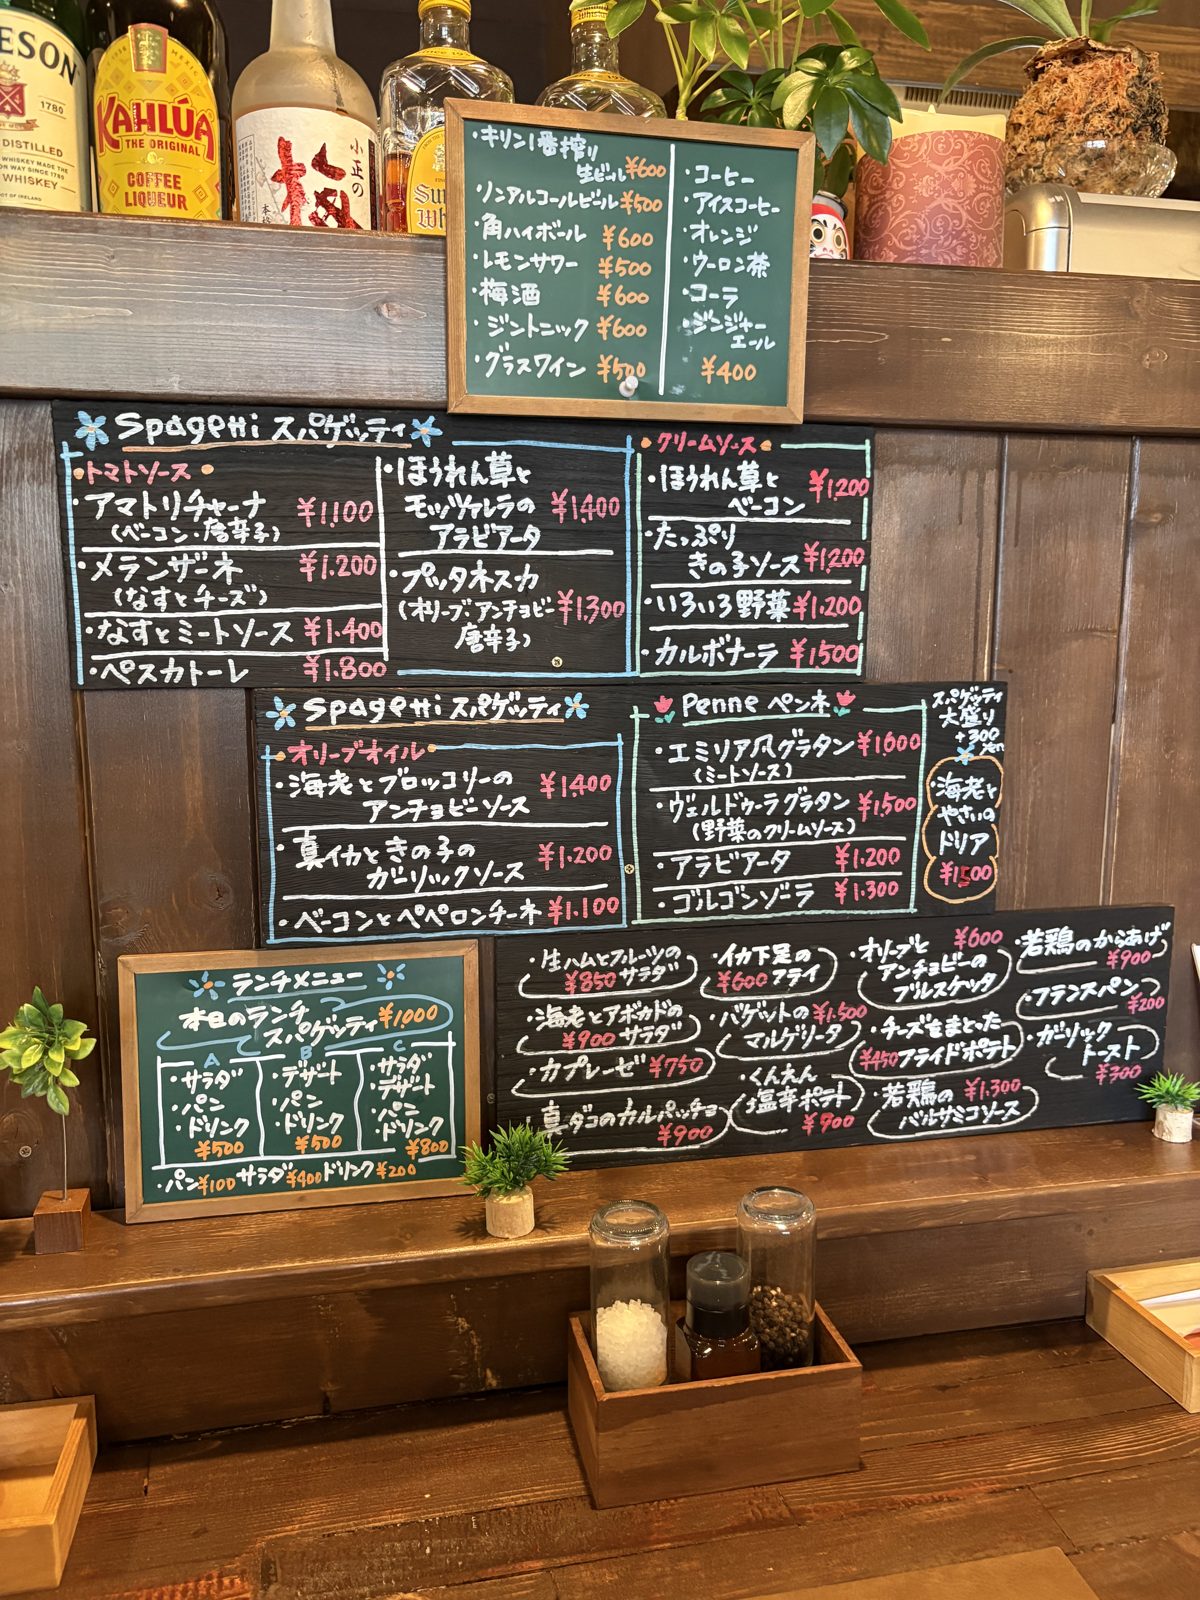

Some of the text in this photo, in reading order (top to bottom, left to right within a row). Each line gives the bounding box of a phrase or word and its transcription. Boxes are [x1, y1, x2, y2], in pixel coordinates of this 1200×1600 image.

[40, 100, 64, 115] 1780
[96, 95, 214, 162] KAHLÚA
[2, 139, 63, 157] DISTILLED
[125, 139, 200, 157] THE ORIGINAL
[2, 156, 69, 175] WHISKEY MADE THE
[28, 167, 48, 176] SINCE
[350, 137, 364, 197] 小正の
[577, 156, 666, 184] 生ビール ¥600
[695, 165, 754, 186] コーヒー
[3, 174, 58, 190] WHISKEY
[127, 171, 182, 190] COFFEE
[125, 192, 188, 211] LIQUEUR
[620, 190, 663, 215] ¥500
[694, 192, 780, 216] アイスコーヒー
[482, 213, 653, 250] 角ハイボール ¥600
[690, 219, 758, 246] オレンジ
[484, 250, 651, 278] レモンサワー ¥500
[692, 252, 770, 279] ウーロン茶
[479, 277, 649, 307] 梅酒 ¥600
[690, 283, 739, 309] コーラ
[488, 313, 647, 342] ジントニック ¥600
[691, 309, 766, 335] ジンジャー
[731, 336, 776, 351] エール
[485, 343, 586, 378] グラスワイン
[701, 354, 756, 385] ¥400
[272, 412, 406, 448] スパゲッティ
[657, 431, 756, 456] クリームソース
[87, 460, 192, 485] トマトソース
[398, 451, 532, 489] ほうれん草と
[661, 460, 779, 493] ほうれん草と
[84, 488, 266, 522] アマトリチャーナ
[728, 496, 806, 517] ベーコン
[429, 523, 541, 550] アラビアータ
[653, 521, 736, 550] たっぷり
[91, 551, 243, 585] メランザーネ
[402, 559, 539, 594] プッタネスカ
[688, 551, 800, 579] きの子ソース
[657, 589, 791, 622] いろいろ野菜
[98, 617, 294, 646] なすとミートソース
[655, 633, 778, 669] カルボナーラ
[100, 657, 249, 686] ペスカトーレ
[449, 691, 562, 720] スパゲッティ
[682, 689, 831, 717] Penne ペンネ
[932, 685, 1003, 709] スパゲッティ
[939, 707, 995, 728] 大盛り
[287, 739, 425, 766] オリーブオイル
[289, 766, 513, 798] 海老とブロッコリーの
[936, 771, 998, 802] 海老と
[937, 804, 996, 827] やさいの
[292, 829, 476, 871] 真イカときの子の
[939, 829, 990, 856] ドリア
[367, 860, 525, 893] ガーリックソース
[671, 850, 791, 881] アラビアータ
[673, 881, 815, 914] ゴルゴンゾーラ
[294, 898, 542, 933] ベーコンとペペロンチーネ
[718, 942, 812, 967] イカ下足の
[858, 926, 1003, 963] オリーブと ¥600
[1020, 922, 1171, 959] 若鶏のからあげ
[541, 945, 681, 972] 生ハムとフルーツの
[877, 952, 987, 981] アンチョビーの
[1106, 949, 1151, 970] ¥900
[232, 969, 363, 996] ランチメニュー
[565, 962, 680, 994] ¥850 サラダ
[717, 963, 820, 993] ¥600 フライ
[893, 972, 997, 1003] ブルスケッタ
[1032, 976, 1139, 1007] フランスパン
[179, 1000, 310, 1032] 本日のランチ
[535, 999, 683, 1031] 海老とアボカドの
[719, 1000, 809, 1028] バゲットの
[1127, 991, 1165, 1014] ¥200
[263, 1015, 378, 1047] スパゲッティ
[562, 1021, 682, 1049] ¥900 サラダ
[744, 1023, 842, 1051] マルゲリータ
[881, 1011, 1003, 1040] チーズをまとった
[1036, 1020, 1113, 1048] ガーリック
[300, 1046, 313, 1060] B
[393, 1040, 406, 1052] C
[859, 1034, 1016, 1071] ¥450 フライドポテト
[1082, 1035, 1141, 1067] トースト
[203, 1053, 220, 1069] A
[283, 1059, 342, 1088] デザート
[378, 1052, 433, 1077] サラダ
[540, 1054, 704, 1082] カプレーゼ ¥750
[749, 1063, 818, 1086] くんえん
[1096, 1063, 1142, 1085] ¥300
[182, 1068, 243, 1093] サラダ
[378, 1073, 435, 1098] デザート
[882, 1078, 953, 1110] 若鶏の
[182, 1094, 225, 1115] パン
[279, 1090, 323, 1112] パン
[378, 1100, 420, 1122] パン
[898, 1100, 1021, 1130] バルサミコソース
[189, 1114, 250, 1140] ドリンク
[285, 1112, 345, 1136] ドリンク
[382, 1116, 445, 1142] ドリンク
[657, 1123, 713, 1147] ¥900
[802, 1112, 856, 1136] ¥900
[194, 1139, 244, 1161] ¥500
[295, 1134, 342, 1154] ¥500
[405, 1139, 449, 1160] ¥800
[165, 1159, 416, 1196] パン ¥100 サラダ ¥400 ドリンク ¥200
